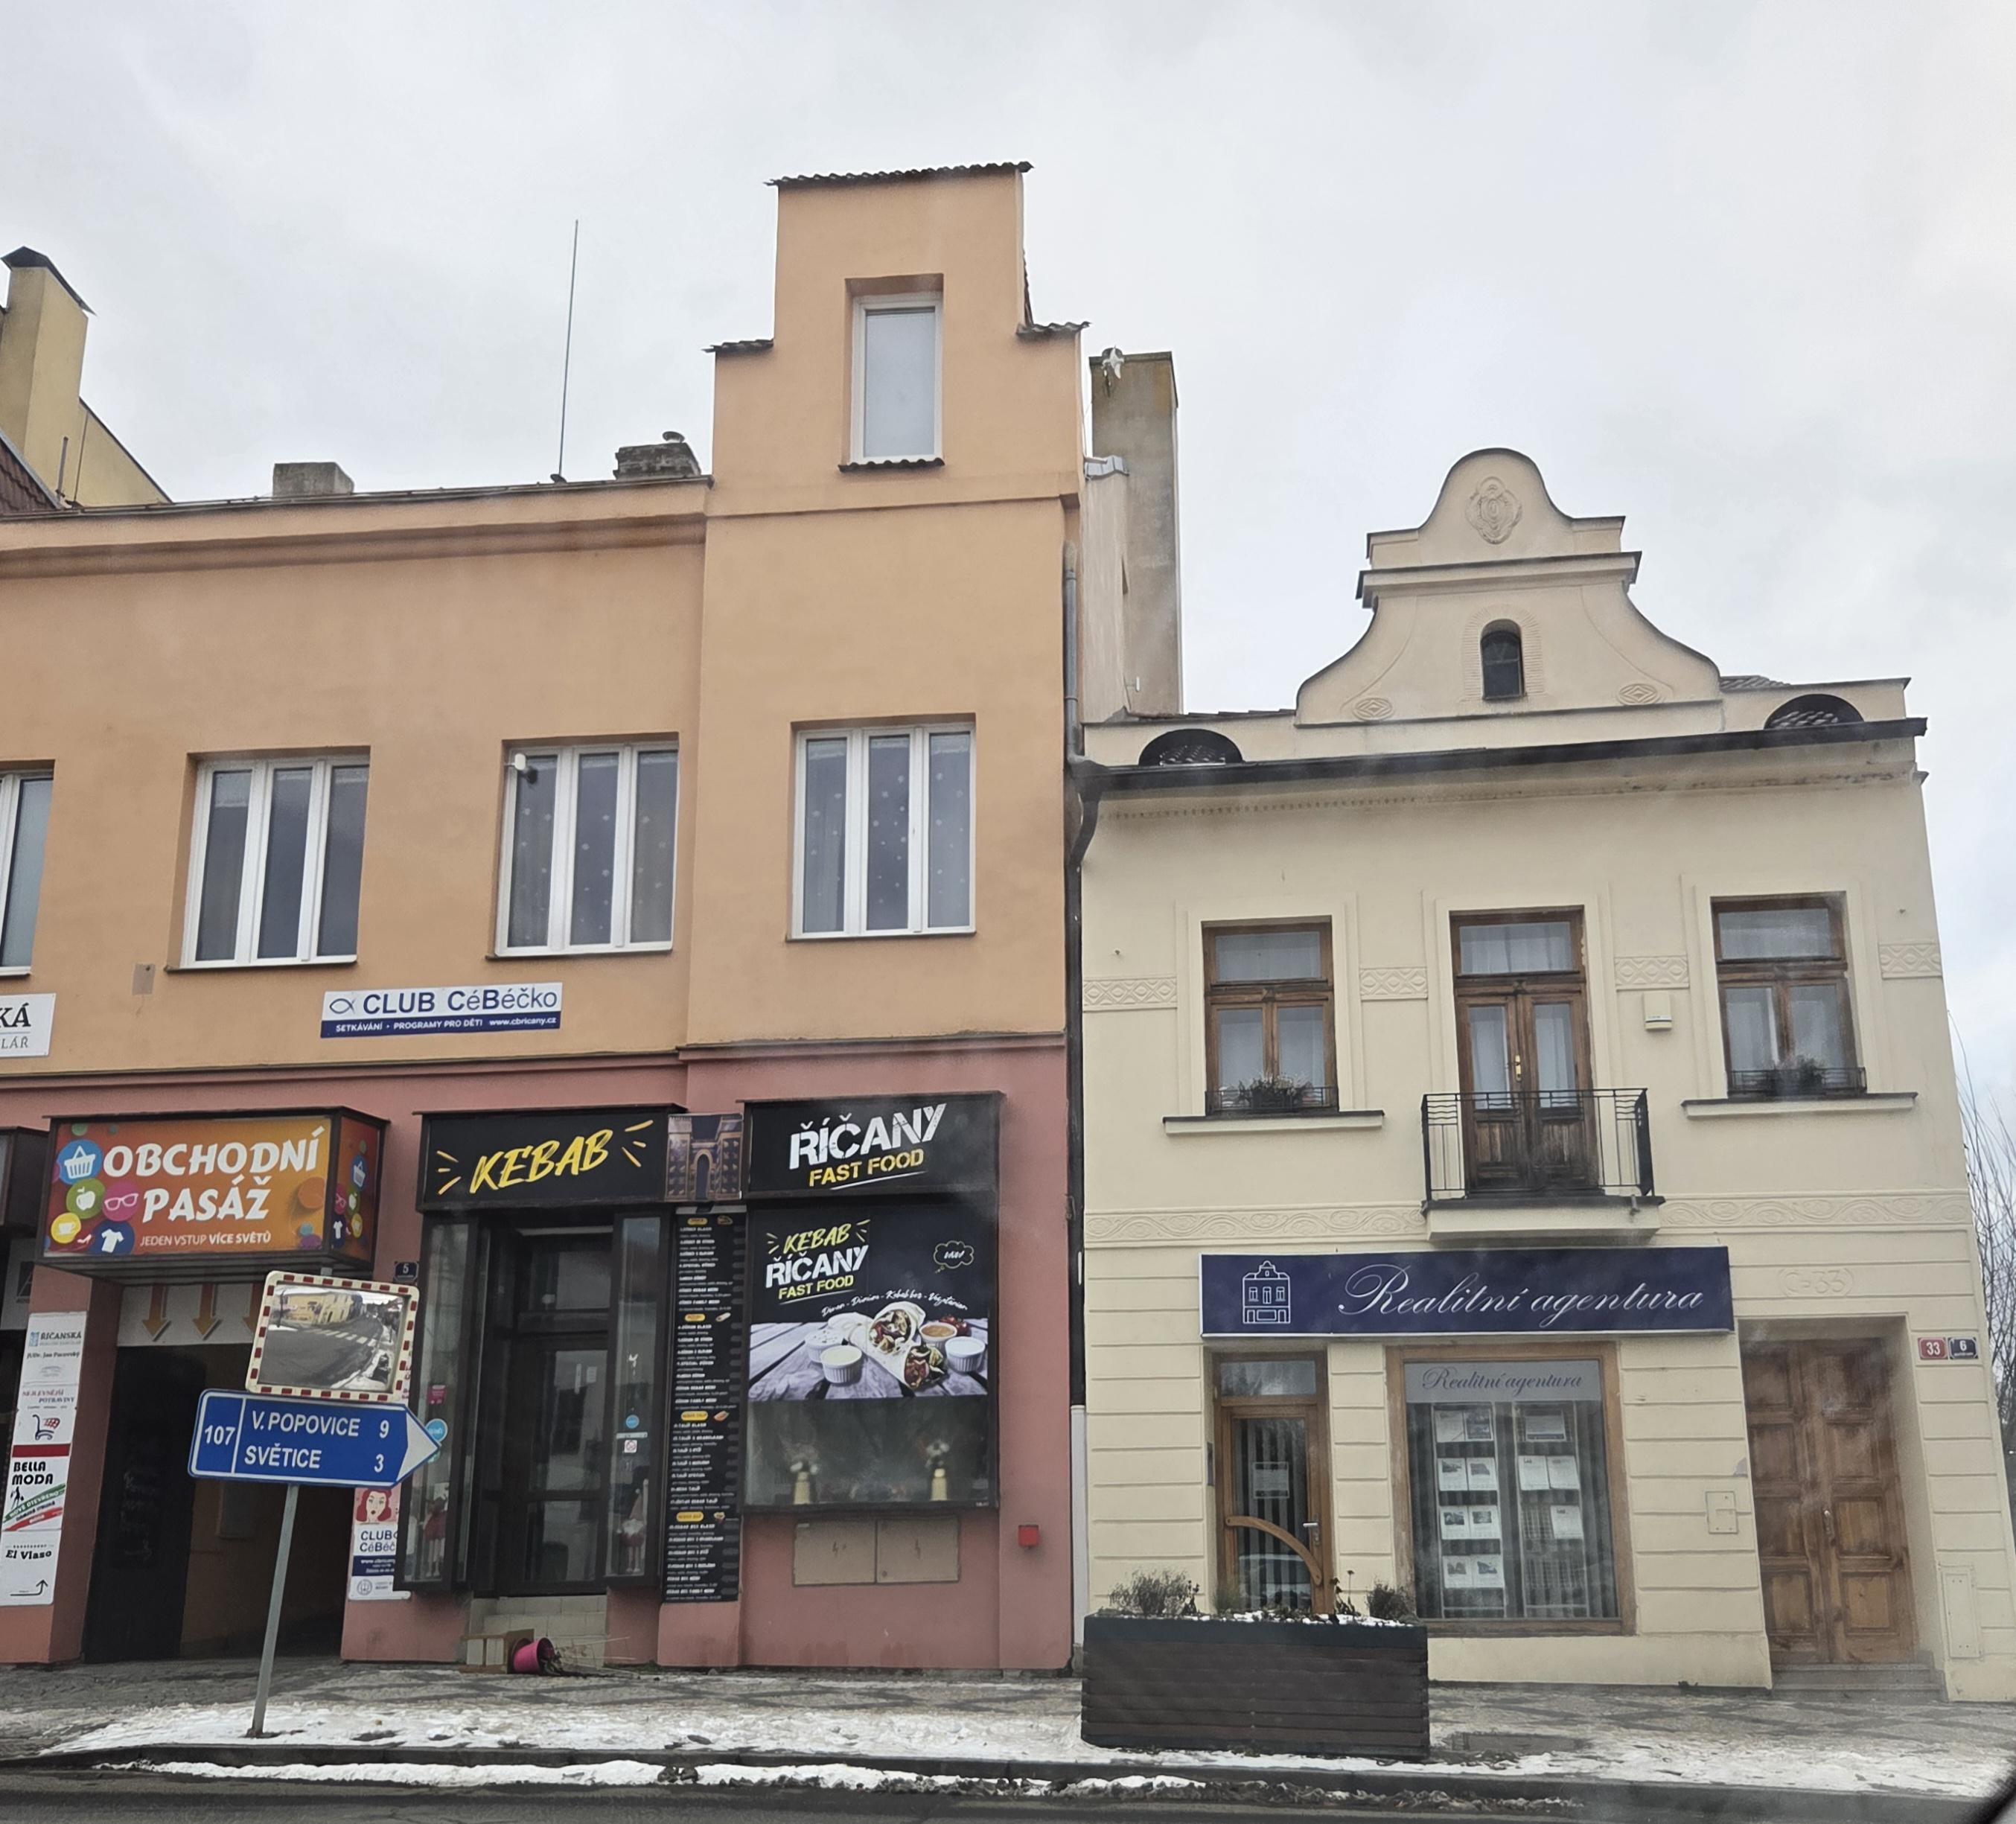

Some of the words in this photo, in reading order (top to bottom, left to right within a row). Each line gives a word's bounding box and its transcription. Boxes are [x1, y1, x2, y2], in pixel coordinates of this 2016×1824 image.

[363, 992, 436, 1014] CLUB
[447, 987, 558, 1011] CéBéčko
[336, 1021, 383, 1033] SETKÁVÁNÍ
[394, 1019, 442, 1030] PROGRAMY
[444, 1018, 462, 1028] PRO
[463, 1017, 483, 1027] DĚTI
[488, 1016, 557, 1027] www.cbricany.cz
[789, 1103, 947, 1170] ŘÍČANY
[103, 1126, 325, 1177] OBCHODNÍ
[469, 1129, 613, 1194] KEBAB
[808, 1161, 863, 1187] FAST
[867, 1149, 925, 1175] FOOD
[142, 1174, 272, 1223] PASÁŽ
[140, 1234, 172, 1246] JEDEN
[173, 1234, 208, 1246] VSTUP
[208, 1232, 235, 1244] VÍCE
[235, 1230, 272, 1244] SVĚTŮ
[782, 1223, 852, 1254] KEBAB
[765, 1245, 869, 1288] ŘÍČANY
[778, 1283, 813, 1299] FAST
[817, 1275, 855, 1292] FOOD
[1338, 1263, 1528, 1316] Realitní
[1530, 1281, 1705, 1328] agentura
[1926, 1342, 1941, 1355] 33
[1959, 1340, 1967, 1351] 6
[1422, 1366, 1503, 1390] Realitní
[1504, 1372, 1583, 1397] agentura
[204, 1425, 237, 1446] 107
[252, 1410, 264, 1431] V.
[267, 1412, 361, 1437] POPOVICE
[379, 1420, 390, 1438] 9
[13, 1461, 46, 1473] BELLA
[244, 1443, 322, 1469] SVĚTICE
[374, 1453, 385, 1473] 3
[12, 1473, 54, 1485] MODA
[360, 1530, 392, 1541] CLUB
[6, 1549, 18, 1559] El
[20, 1550, 52, 1560] Vlaso
